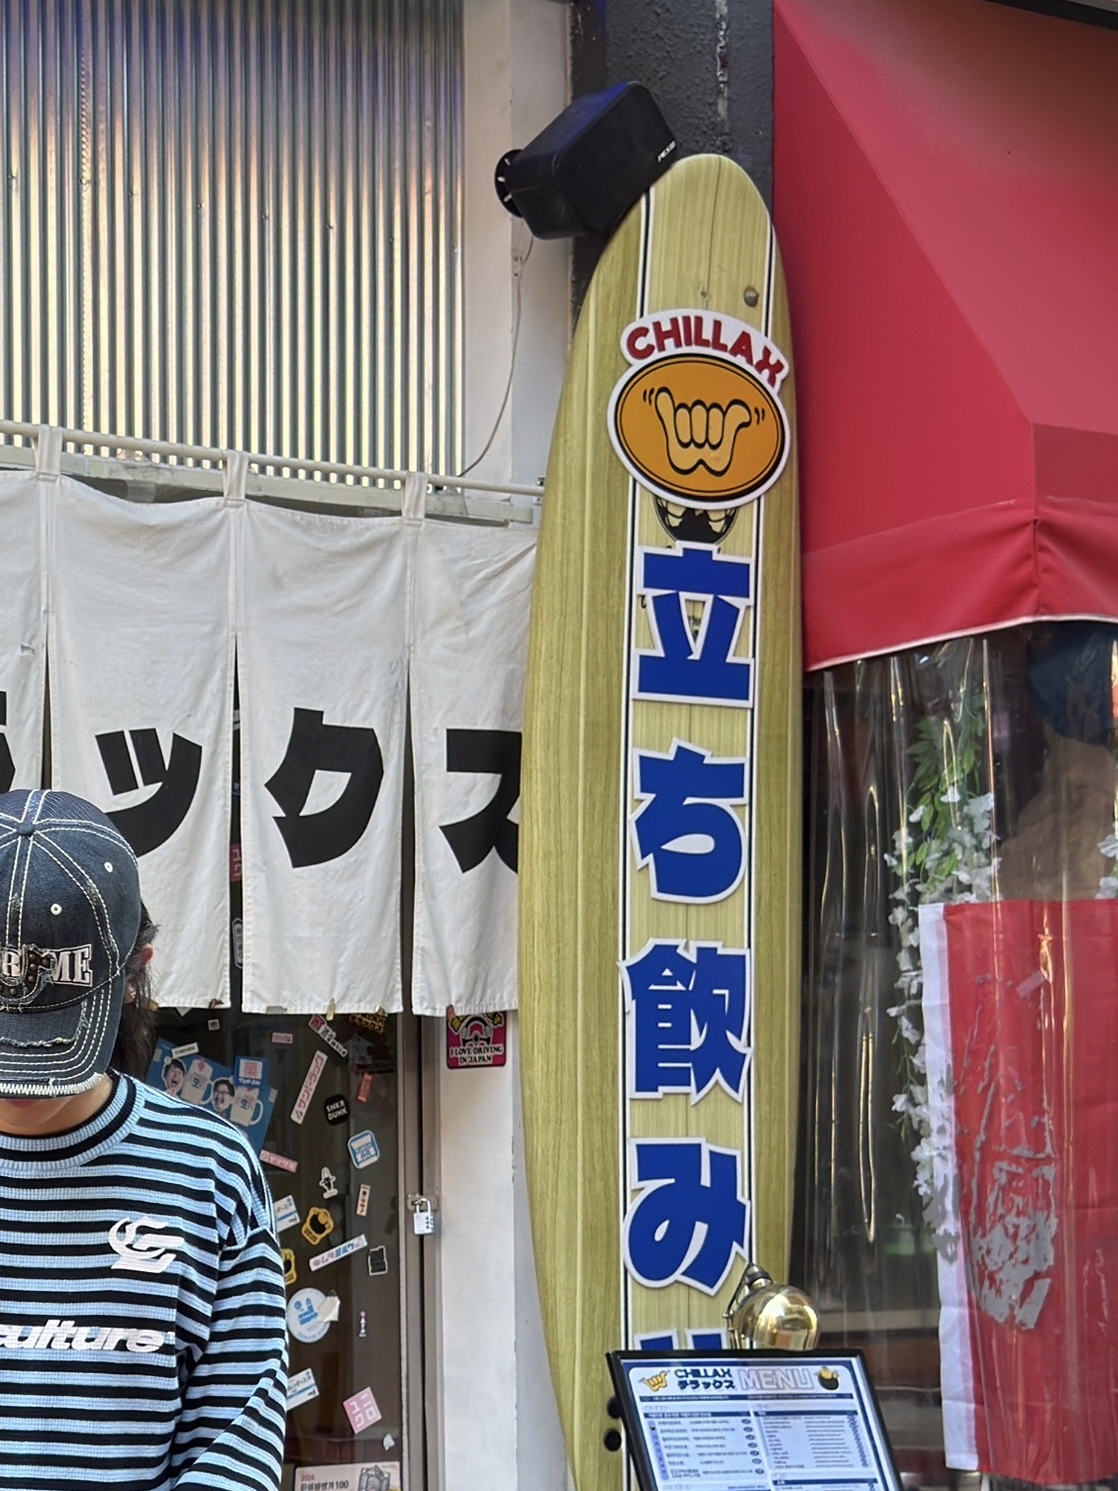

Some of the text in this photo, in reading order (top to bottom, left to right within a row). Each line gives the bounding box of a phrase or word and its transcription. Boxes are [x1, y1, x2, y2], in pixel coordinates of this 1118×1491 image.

[625, 315, 786, 390] CHILLAX
[626, 548, 752, 1352] 立ち飲み
[455, 1047, 472, 1056] LOVE
[473, 1045, 502, 1055] DRIVING
[459, 1055, 491, 1064] IN JAPAN
[326, 1099, 346, 1112] SNKR
[327, 1107, 348, 1121] DUNK
[673, 1367, 815, 1391] CHILLAX MENU
